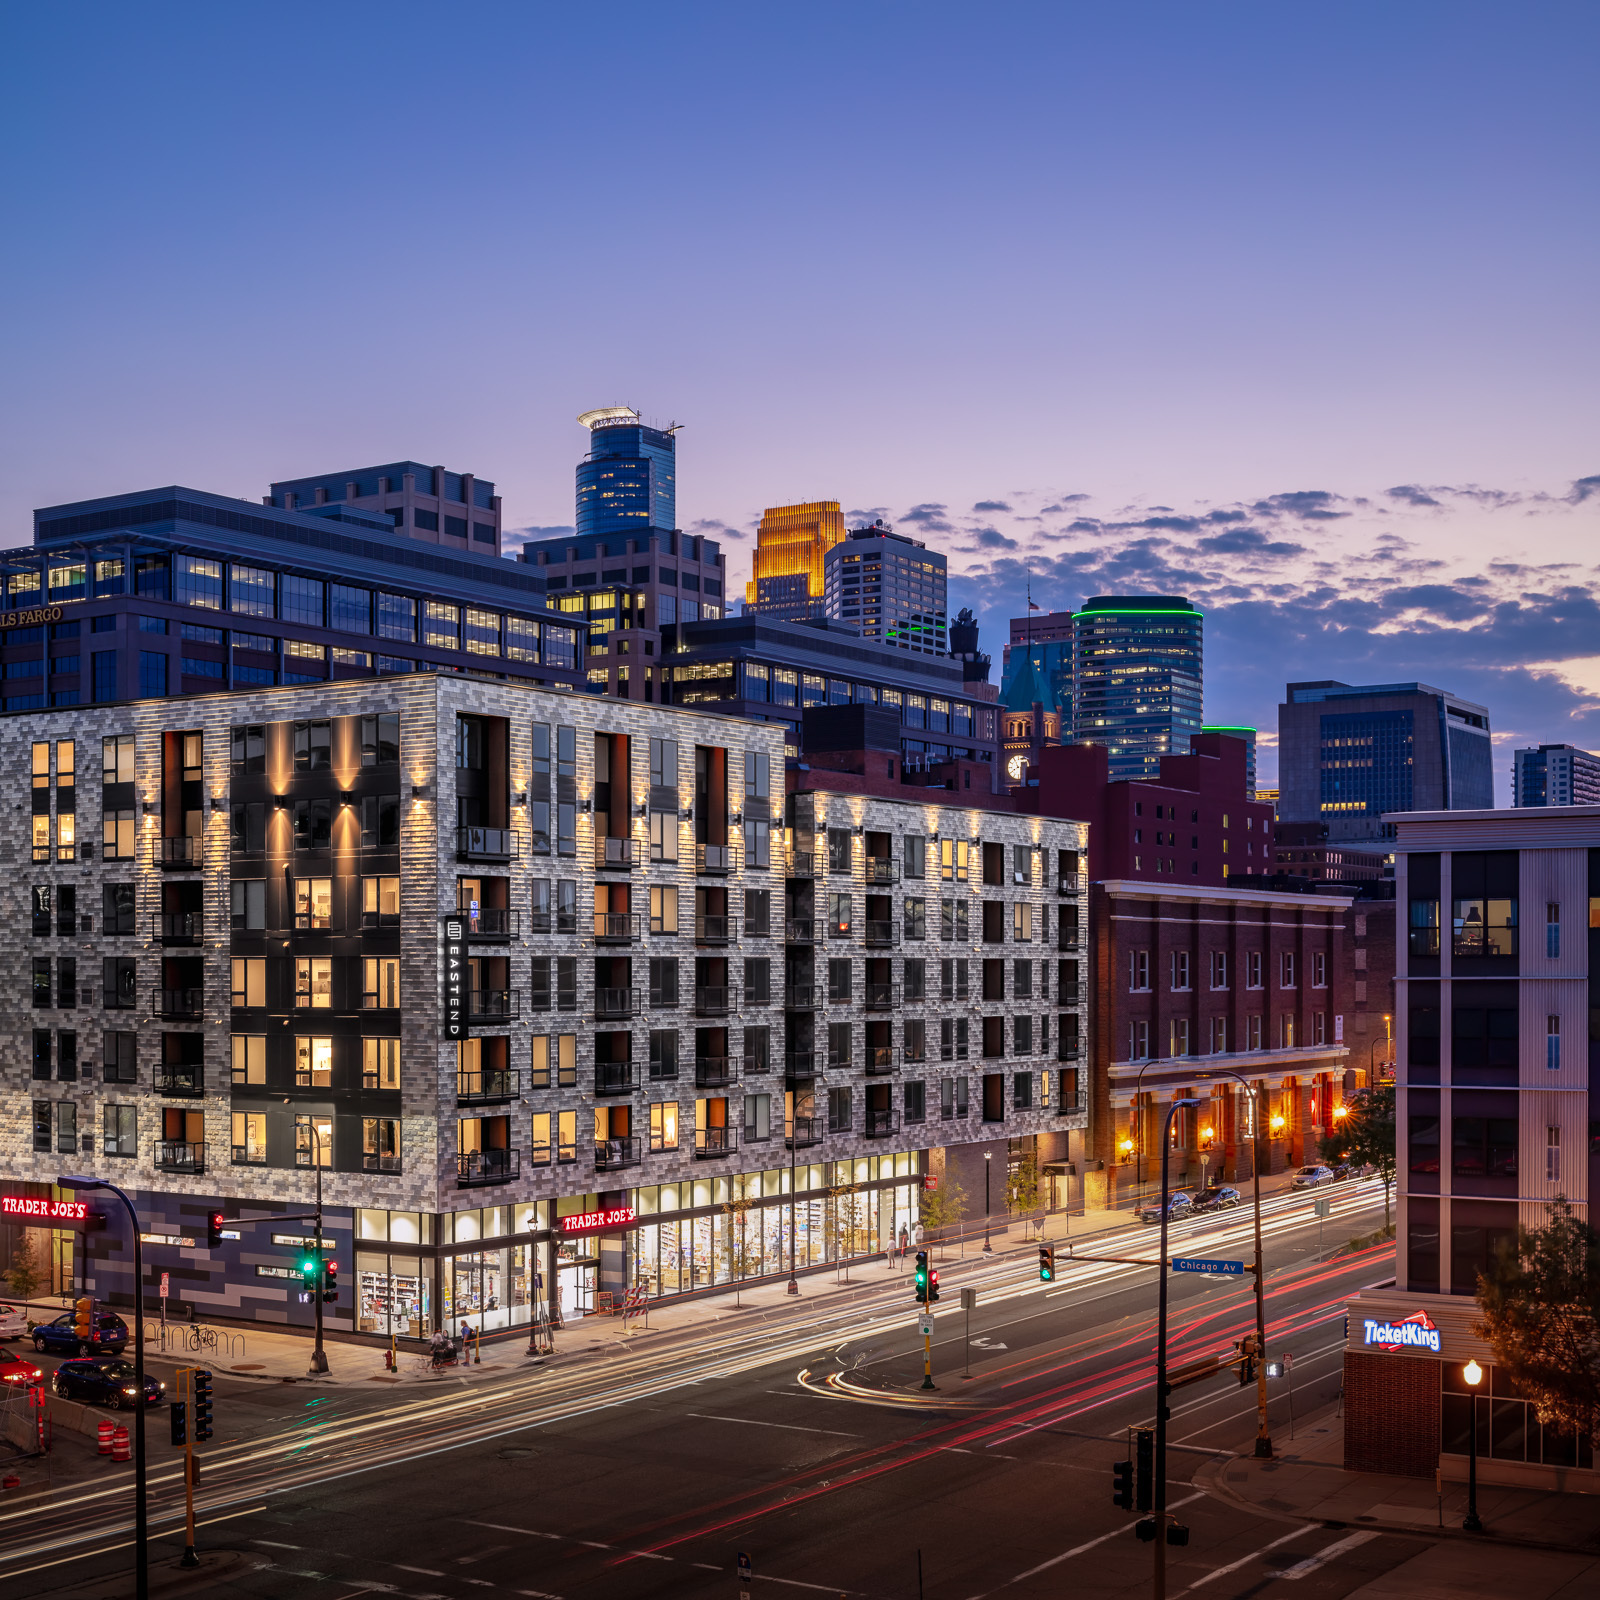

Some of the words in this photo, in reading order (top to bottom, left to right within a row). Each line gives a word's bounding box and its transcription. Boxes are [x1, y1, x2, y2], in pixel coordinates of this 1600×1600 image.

[0, 613, 17, 627] LS
[19, 607, 62, 625] FARGO
[2, 1197, 49, 1216] TRADER
[50, 1202, 87, 1219] JOE'S
[564, 1212, 605, 1230] TRADER
[606, 1207, 635, 1224] JOE'S
[1180, 1261, 1218, 1272] Chicago
[1222, 1263, 1236, 1272] Av
[1364, 1320, 1440, 1352] TicketKing
